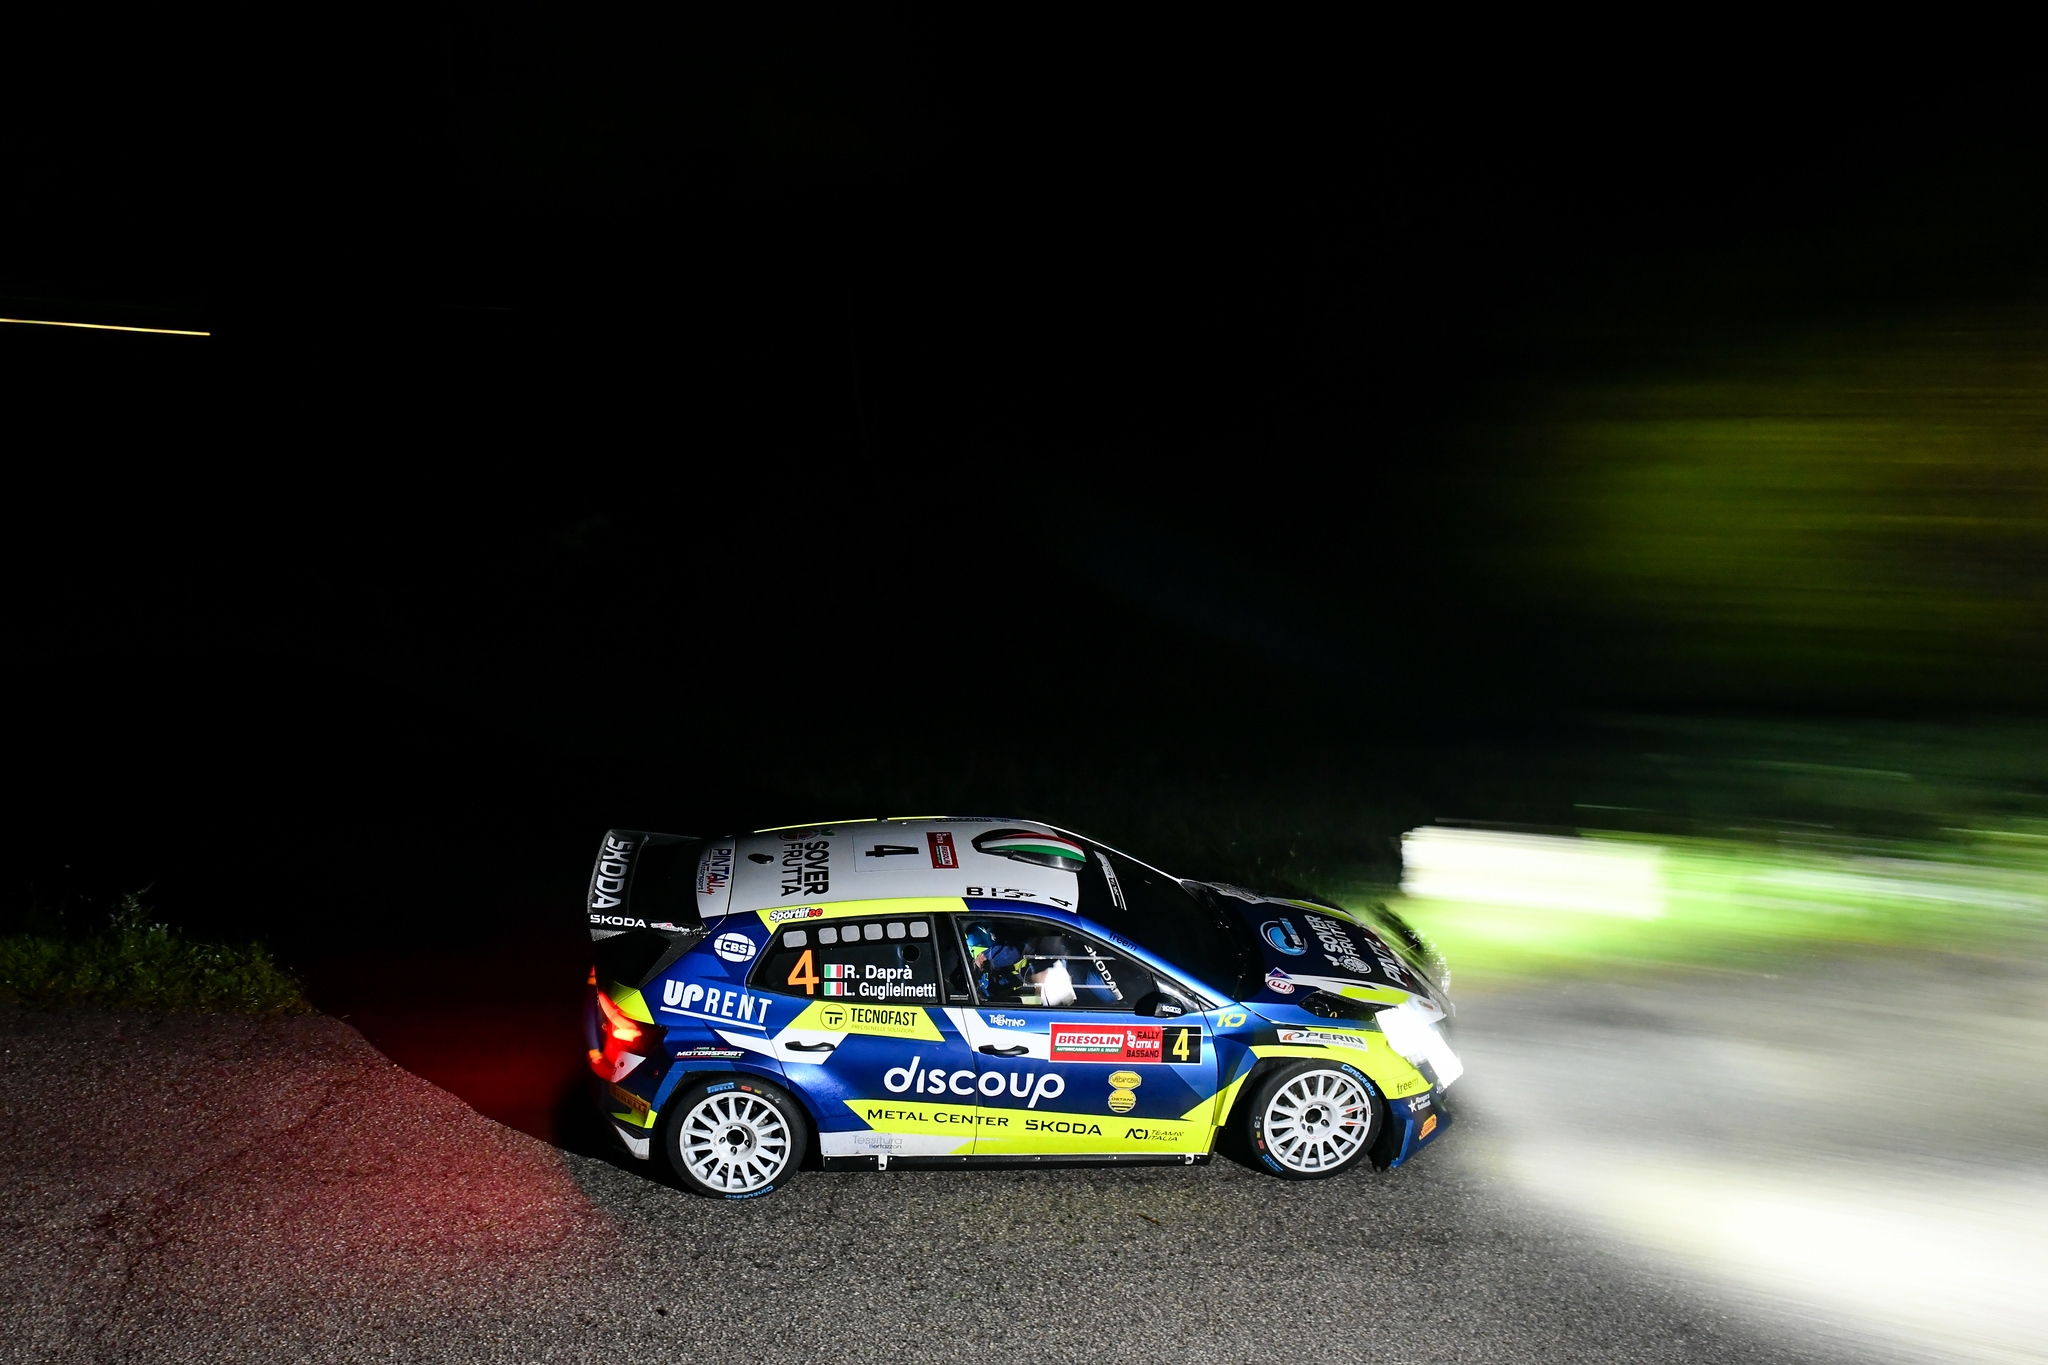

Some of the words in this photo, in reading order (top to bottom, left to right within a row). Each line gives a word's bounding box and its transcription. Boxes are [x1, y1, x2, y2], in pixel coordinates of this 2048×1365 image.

[865, 844, 919, 857] 4
[781, 842, 803, 896] FRUTTA
[803, 841, 830, 896] SOVER
[590, 914, 647, 929] SKODA
[1304, 914, 1343, 954] SOVER
[1323, 919, 1361, 958] FRUTTA
[722, 941, 748, 954] CBS
[787, 949, 820, 995] 4
[844, 965, 860, 979] R.
[865, 964, 913, 982] Daprà
[843, 983, 856, 996] L.
[859, 981, 937, 1000] Guglielmetti
[850, 1007, 917, 1026] TECNOFAST
[1058, 1035, 1121, 1045] BRESOLIN
[1136, 1031, 1160, 1039] RALLY
[1126, 1049, 1159, 1058] BASSANO
[1172, 1028, 1190, 1061] 4
[883, 1055, 1066, 1108] discoup
[866, 1109, 929, 1122] METAL
[933, 1112, 1010, 1127] CENTER
[1025, 1119, 1103, 1136] SKODA
[853, 1134, 903, 1145] Tessitura
